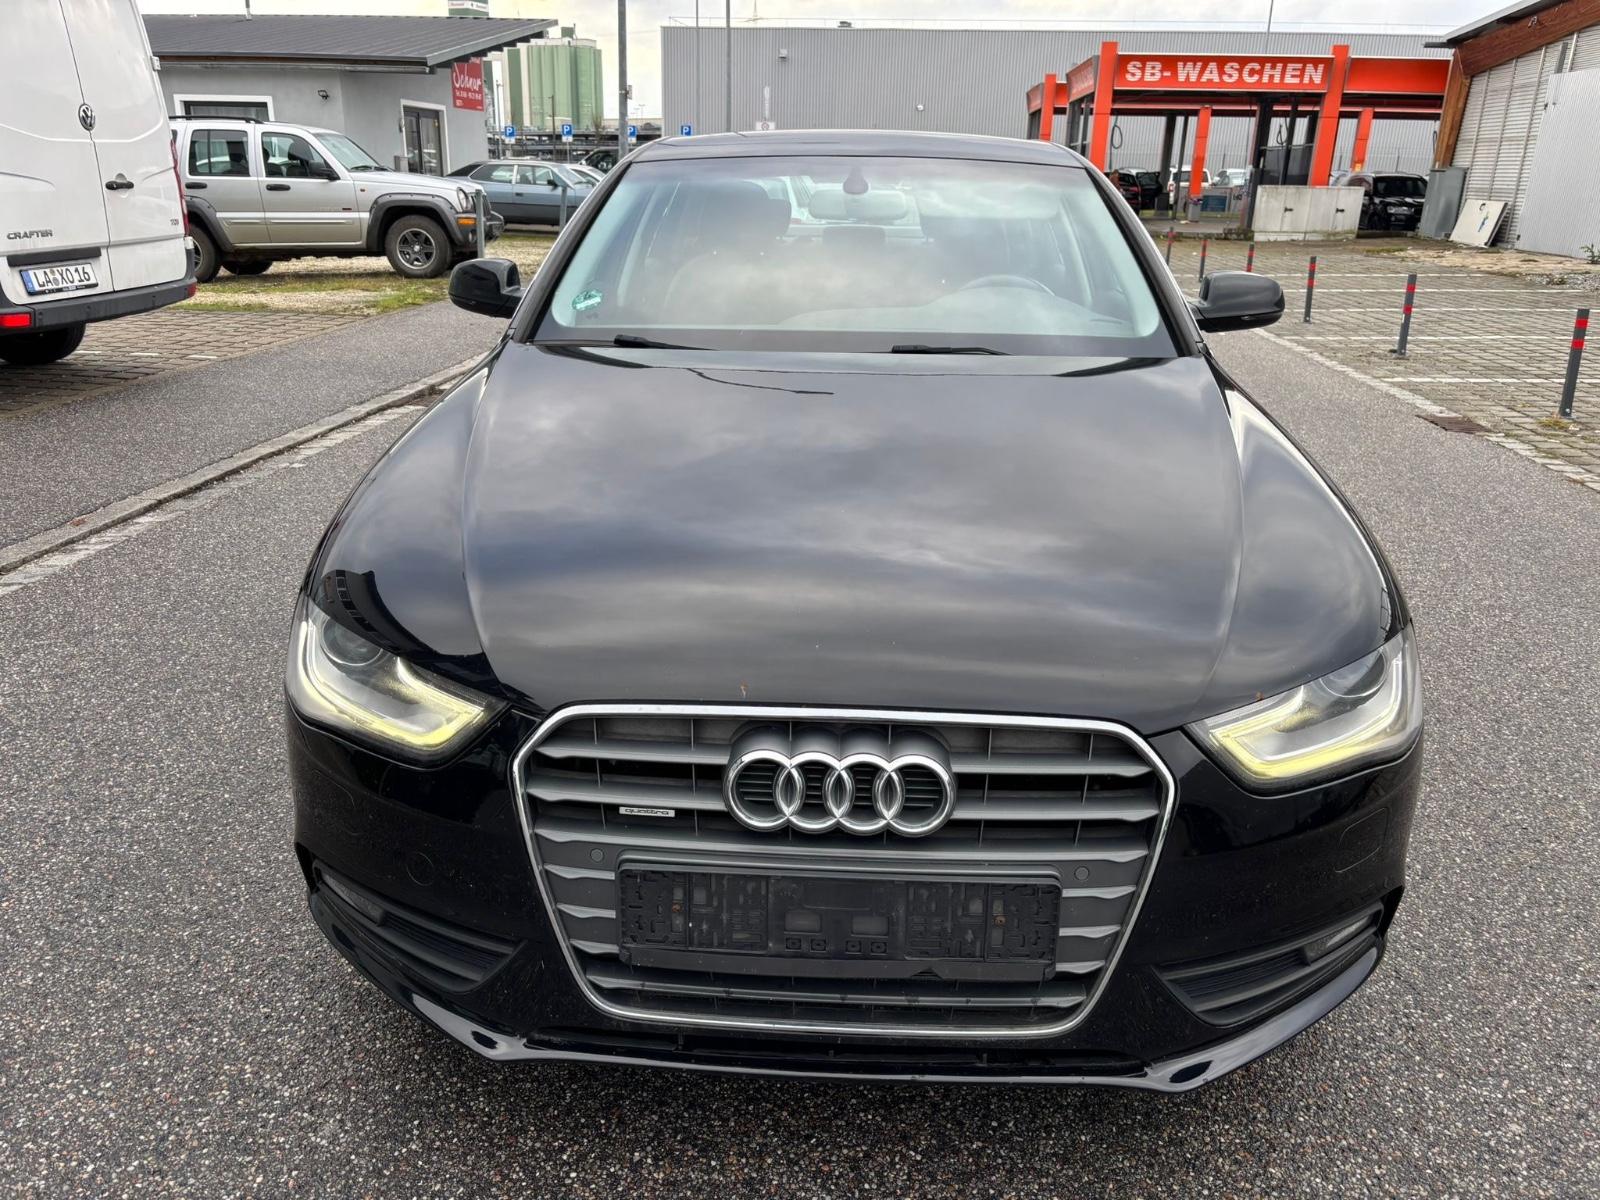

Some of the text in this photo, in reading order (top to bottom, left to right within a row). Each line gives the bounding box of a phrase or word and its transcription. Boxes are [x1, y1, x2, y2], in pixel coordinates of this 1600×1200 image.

[1125, 61, 1325, 84] SB- WASCHEN
[6, 229, 53, 240] CRAFTER
